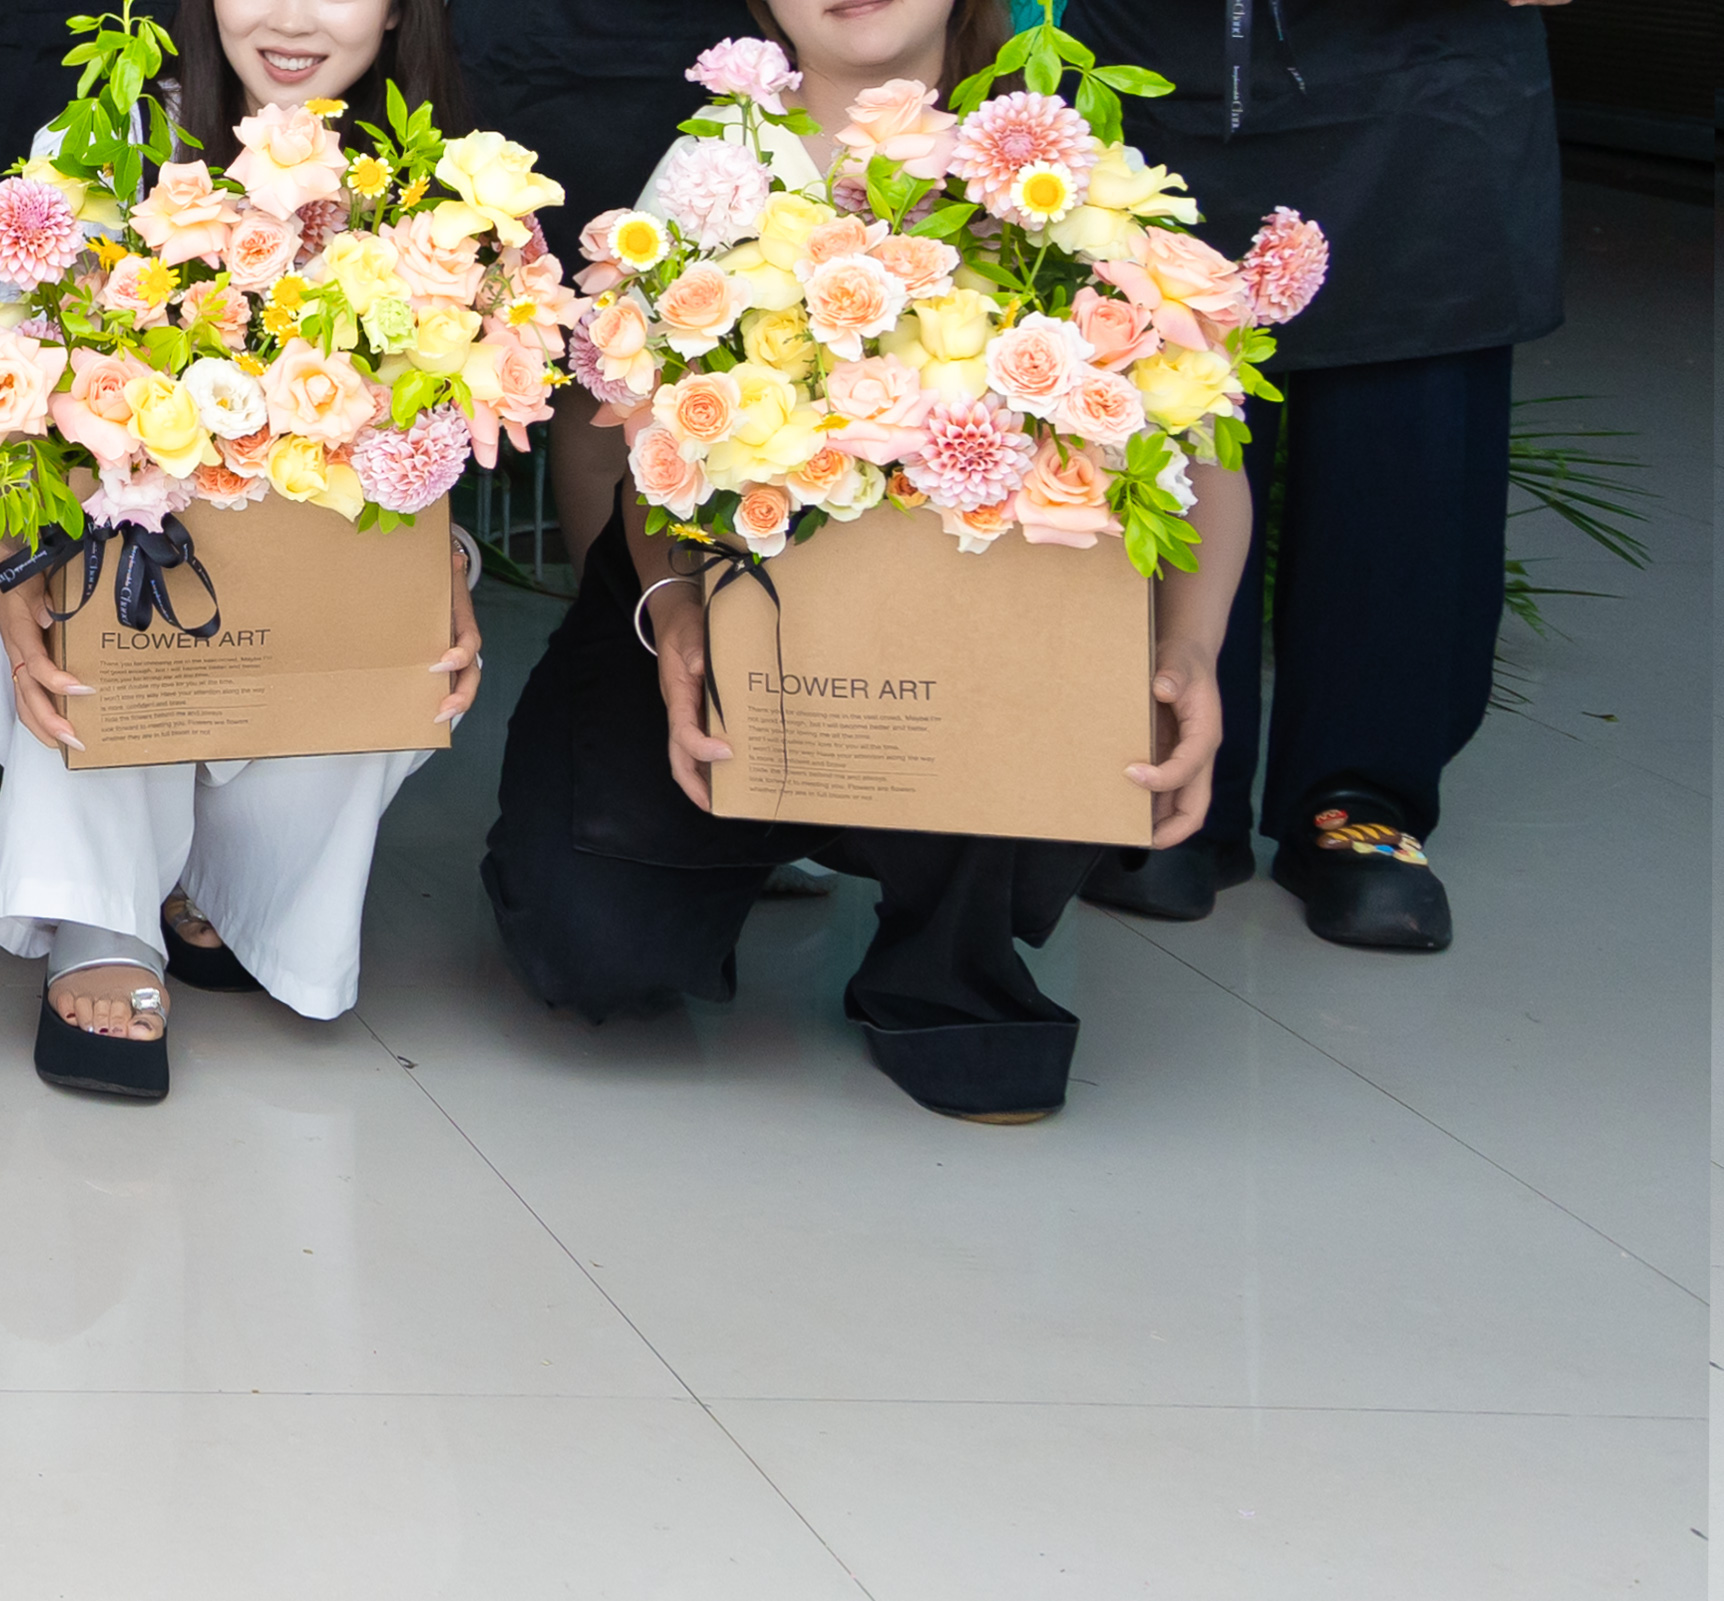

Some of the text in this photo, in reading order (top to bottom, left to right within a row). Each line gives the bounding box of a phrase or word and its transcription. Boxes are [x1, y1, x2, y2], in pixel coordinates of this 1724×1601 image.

[101, 629, 270, 651] FLOWER ART
[748, 672, 936, 700] FLOWER ART
